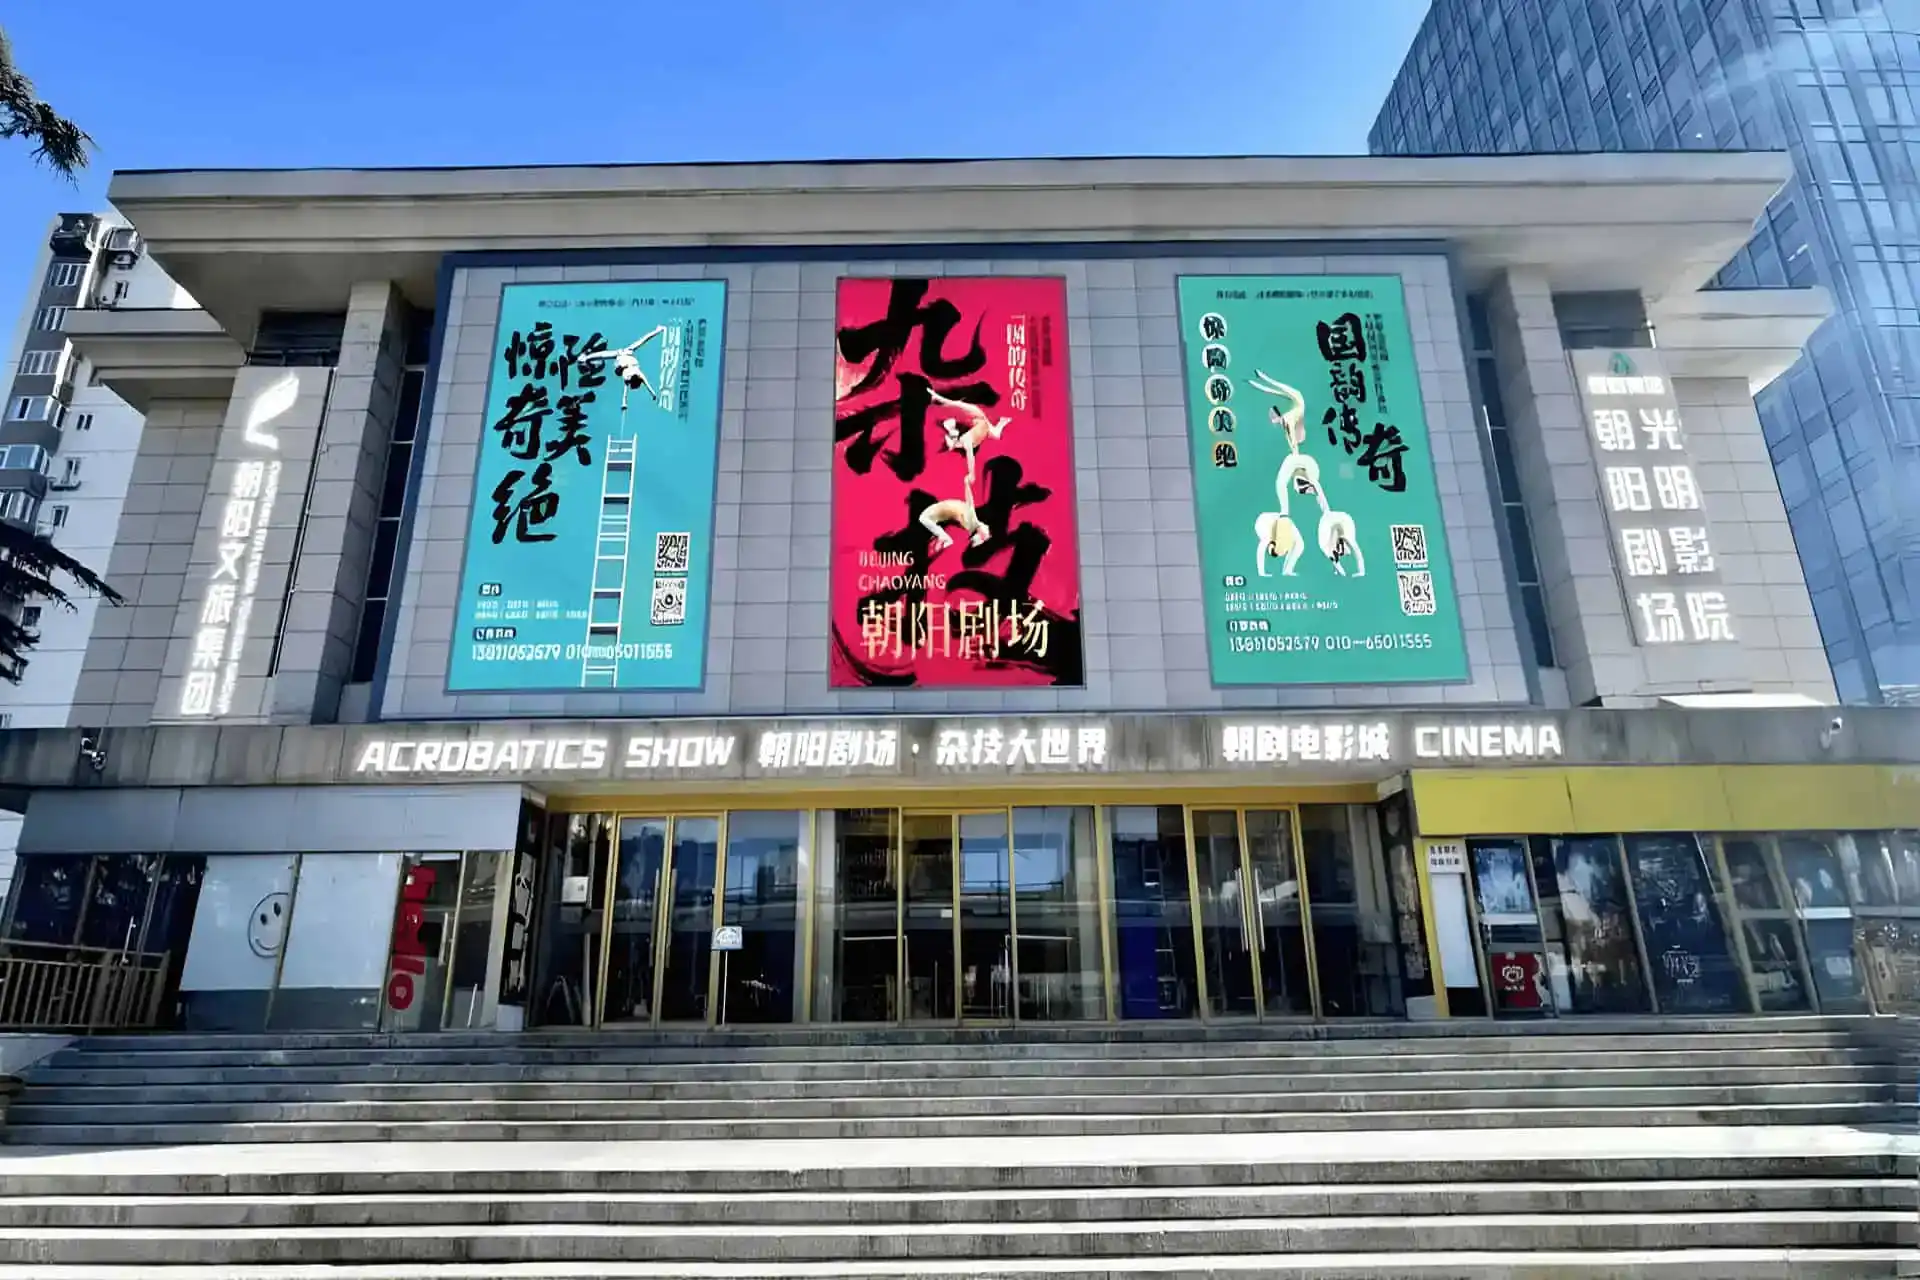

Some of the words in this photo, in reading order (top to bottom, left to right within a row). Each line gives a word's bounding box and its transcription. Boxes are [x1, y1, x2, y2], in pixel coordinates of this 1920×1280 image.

[504, 321, 608, 390] 惊险
[494, 383, 596, 466] 奇美
[491, 463, 559, 545] 绝
[1592, 409, 1685, 642] 朝阳剧场
[1639, 408, 1734, 641] 光明影院
[858, 573, 946, 592] CHAOYANG
[860, 597, 1049, 660] 朝阳剧场
[356, 738, 608, 773] ACROBATICS
[625, 735, 735, 769] SHOW
[1222, 722, 1390, 762] 朝剧电影城
[1415, 724, 1562, 758] CINEMA
